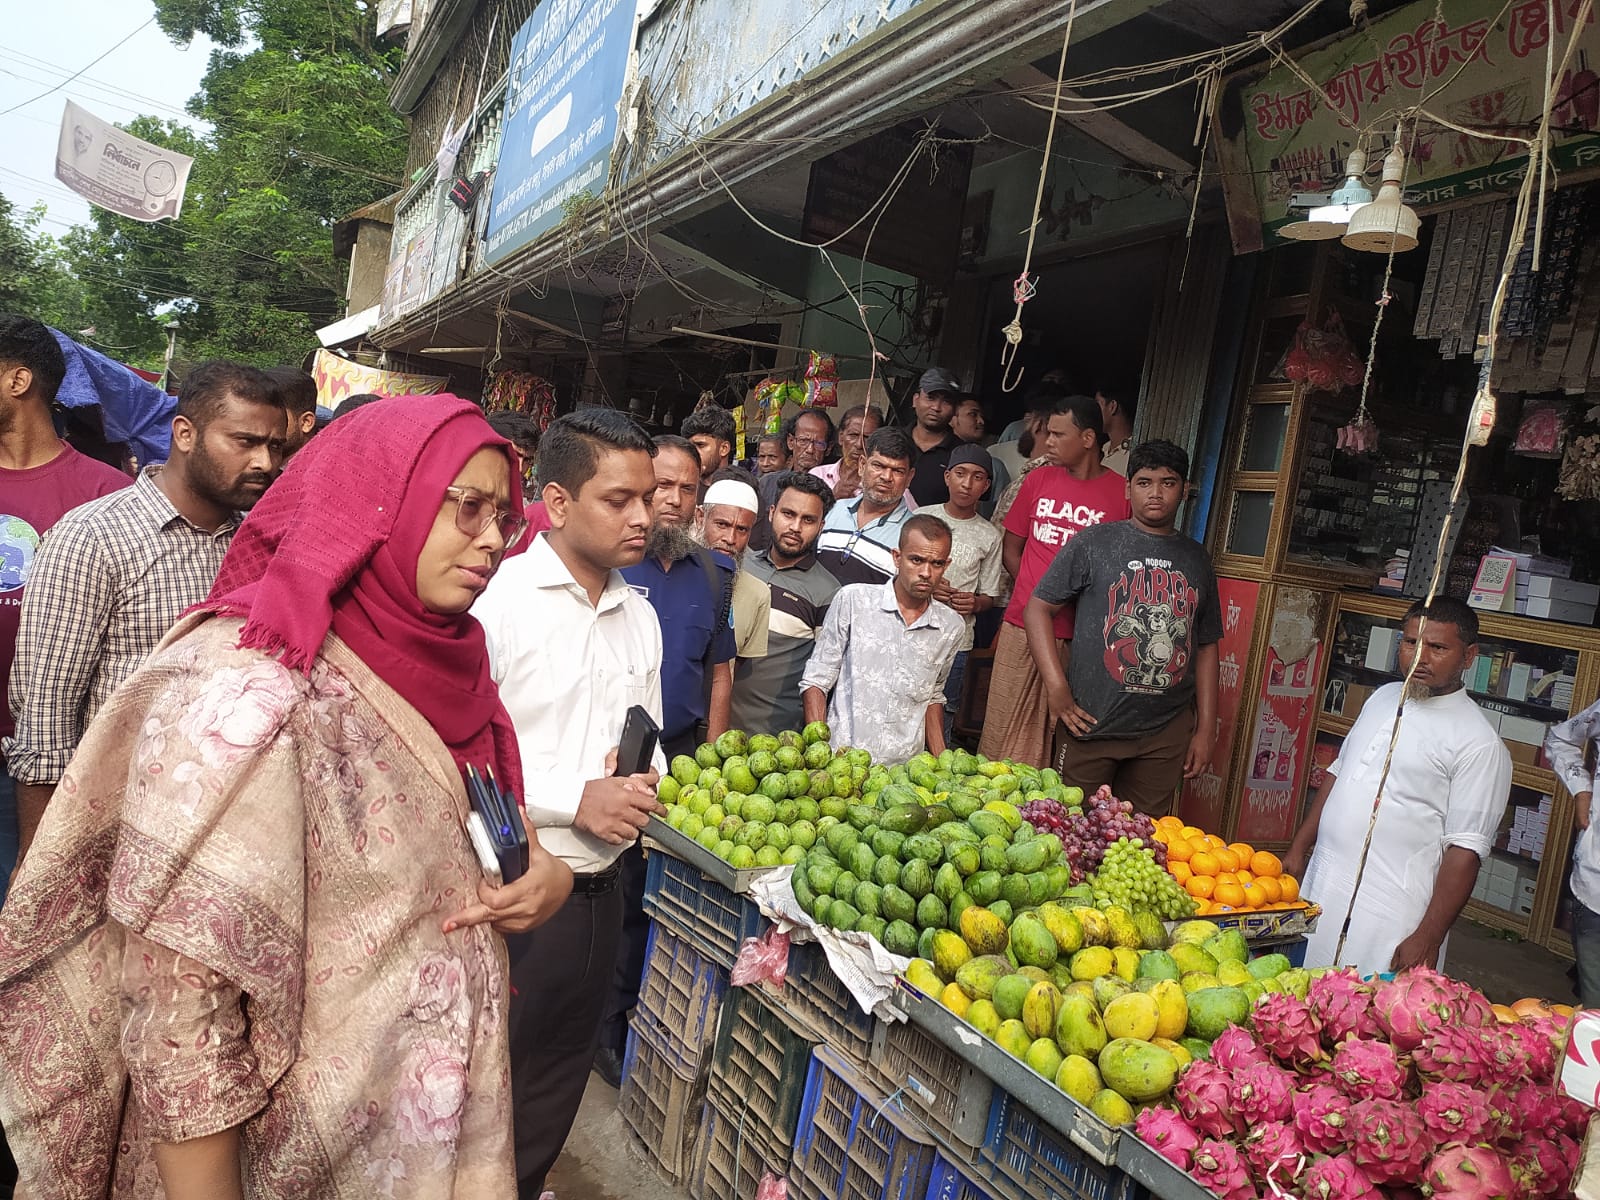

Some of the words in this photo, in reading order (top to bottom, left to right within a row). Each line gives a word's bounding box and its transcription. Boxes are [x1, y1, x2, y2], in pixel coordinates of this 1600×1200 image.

[1251, 90, 1313, 139] ইমন
[103, 142, 141, 171] নির্বাচনে
[1404, 183, 1459, 203] পার
[1036, 498, 1106, 527] BLACK
[1033, 519, 1078, 546] MET
[1145, 557, 1172, 569] NOBODY
